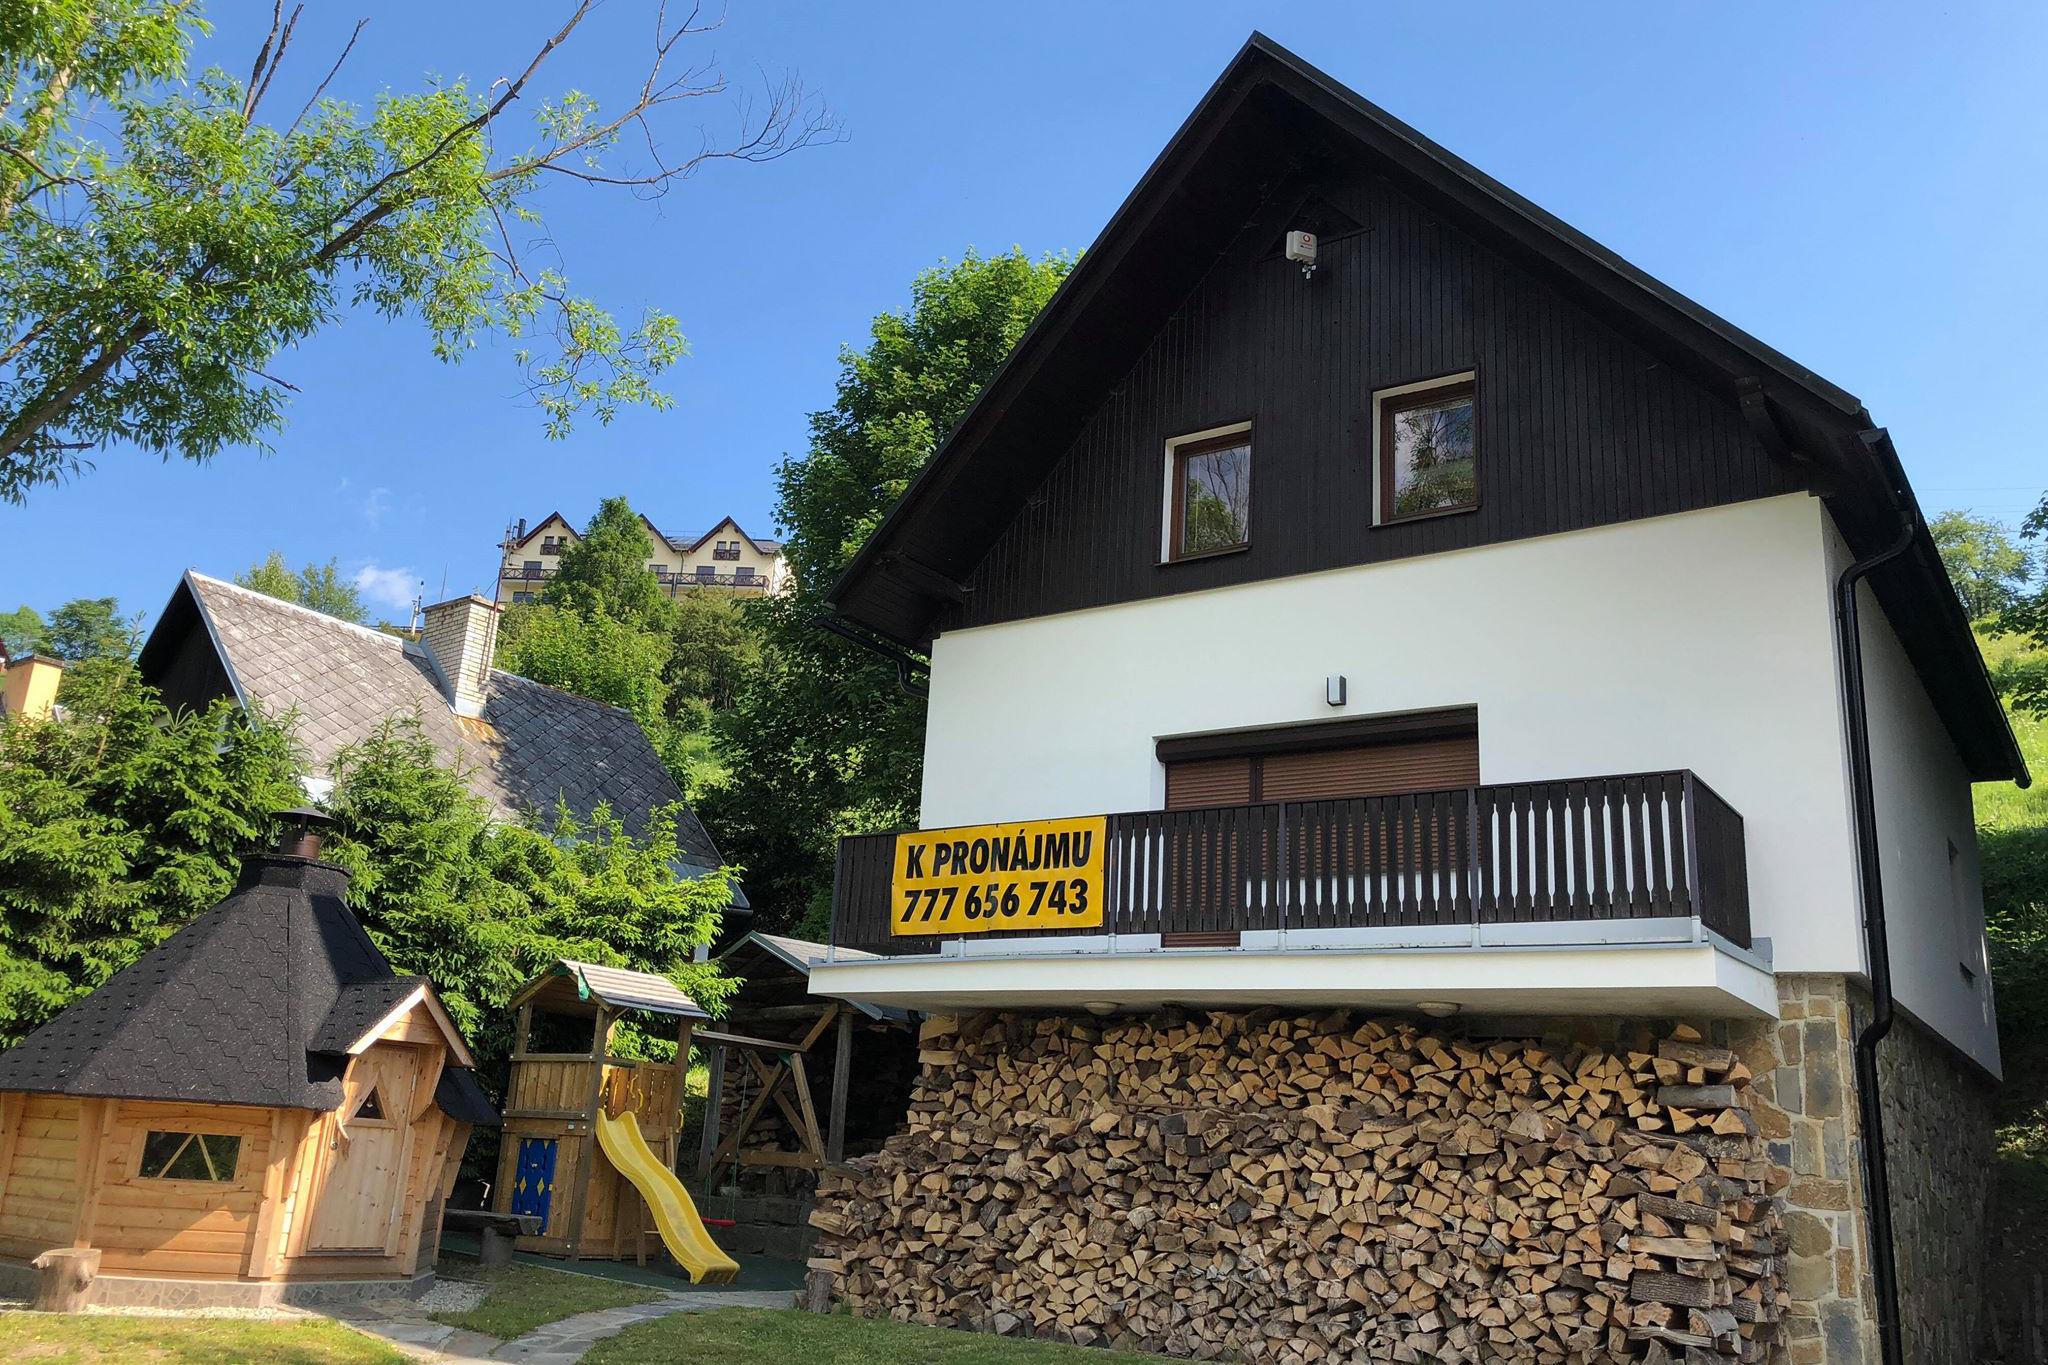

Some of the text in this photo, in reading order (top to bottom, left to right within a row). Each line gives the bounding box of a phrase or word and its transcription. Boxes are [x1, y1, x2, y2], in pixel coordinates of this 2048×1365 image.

[906, 829, 1092, 879] K PRONÁJMU
[900, 878, 1088, 922] 777 656 743
